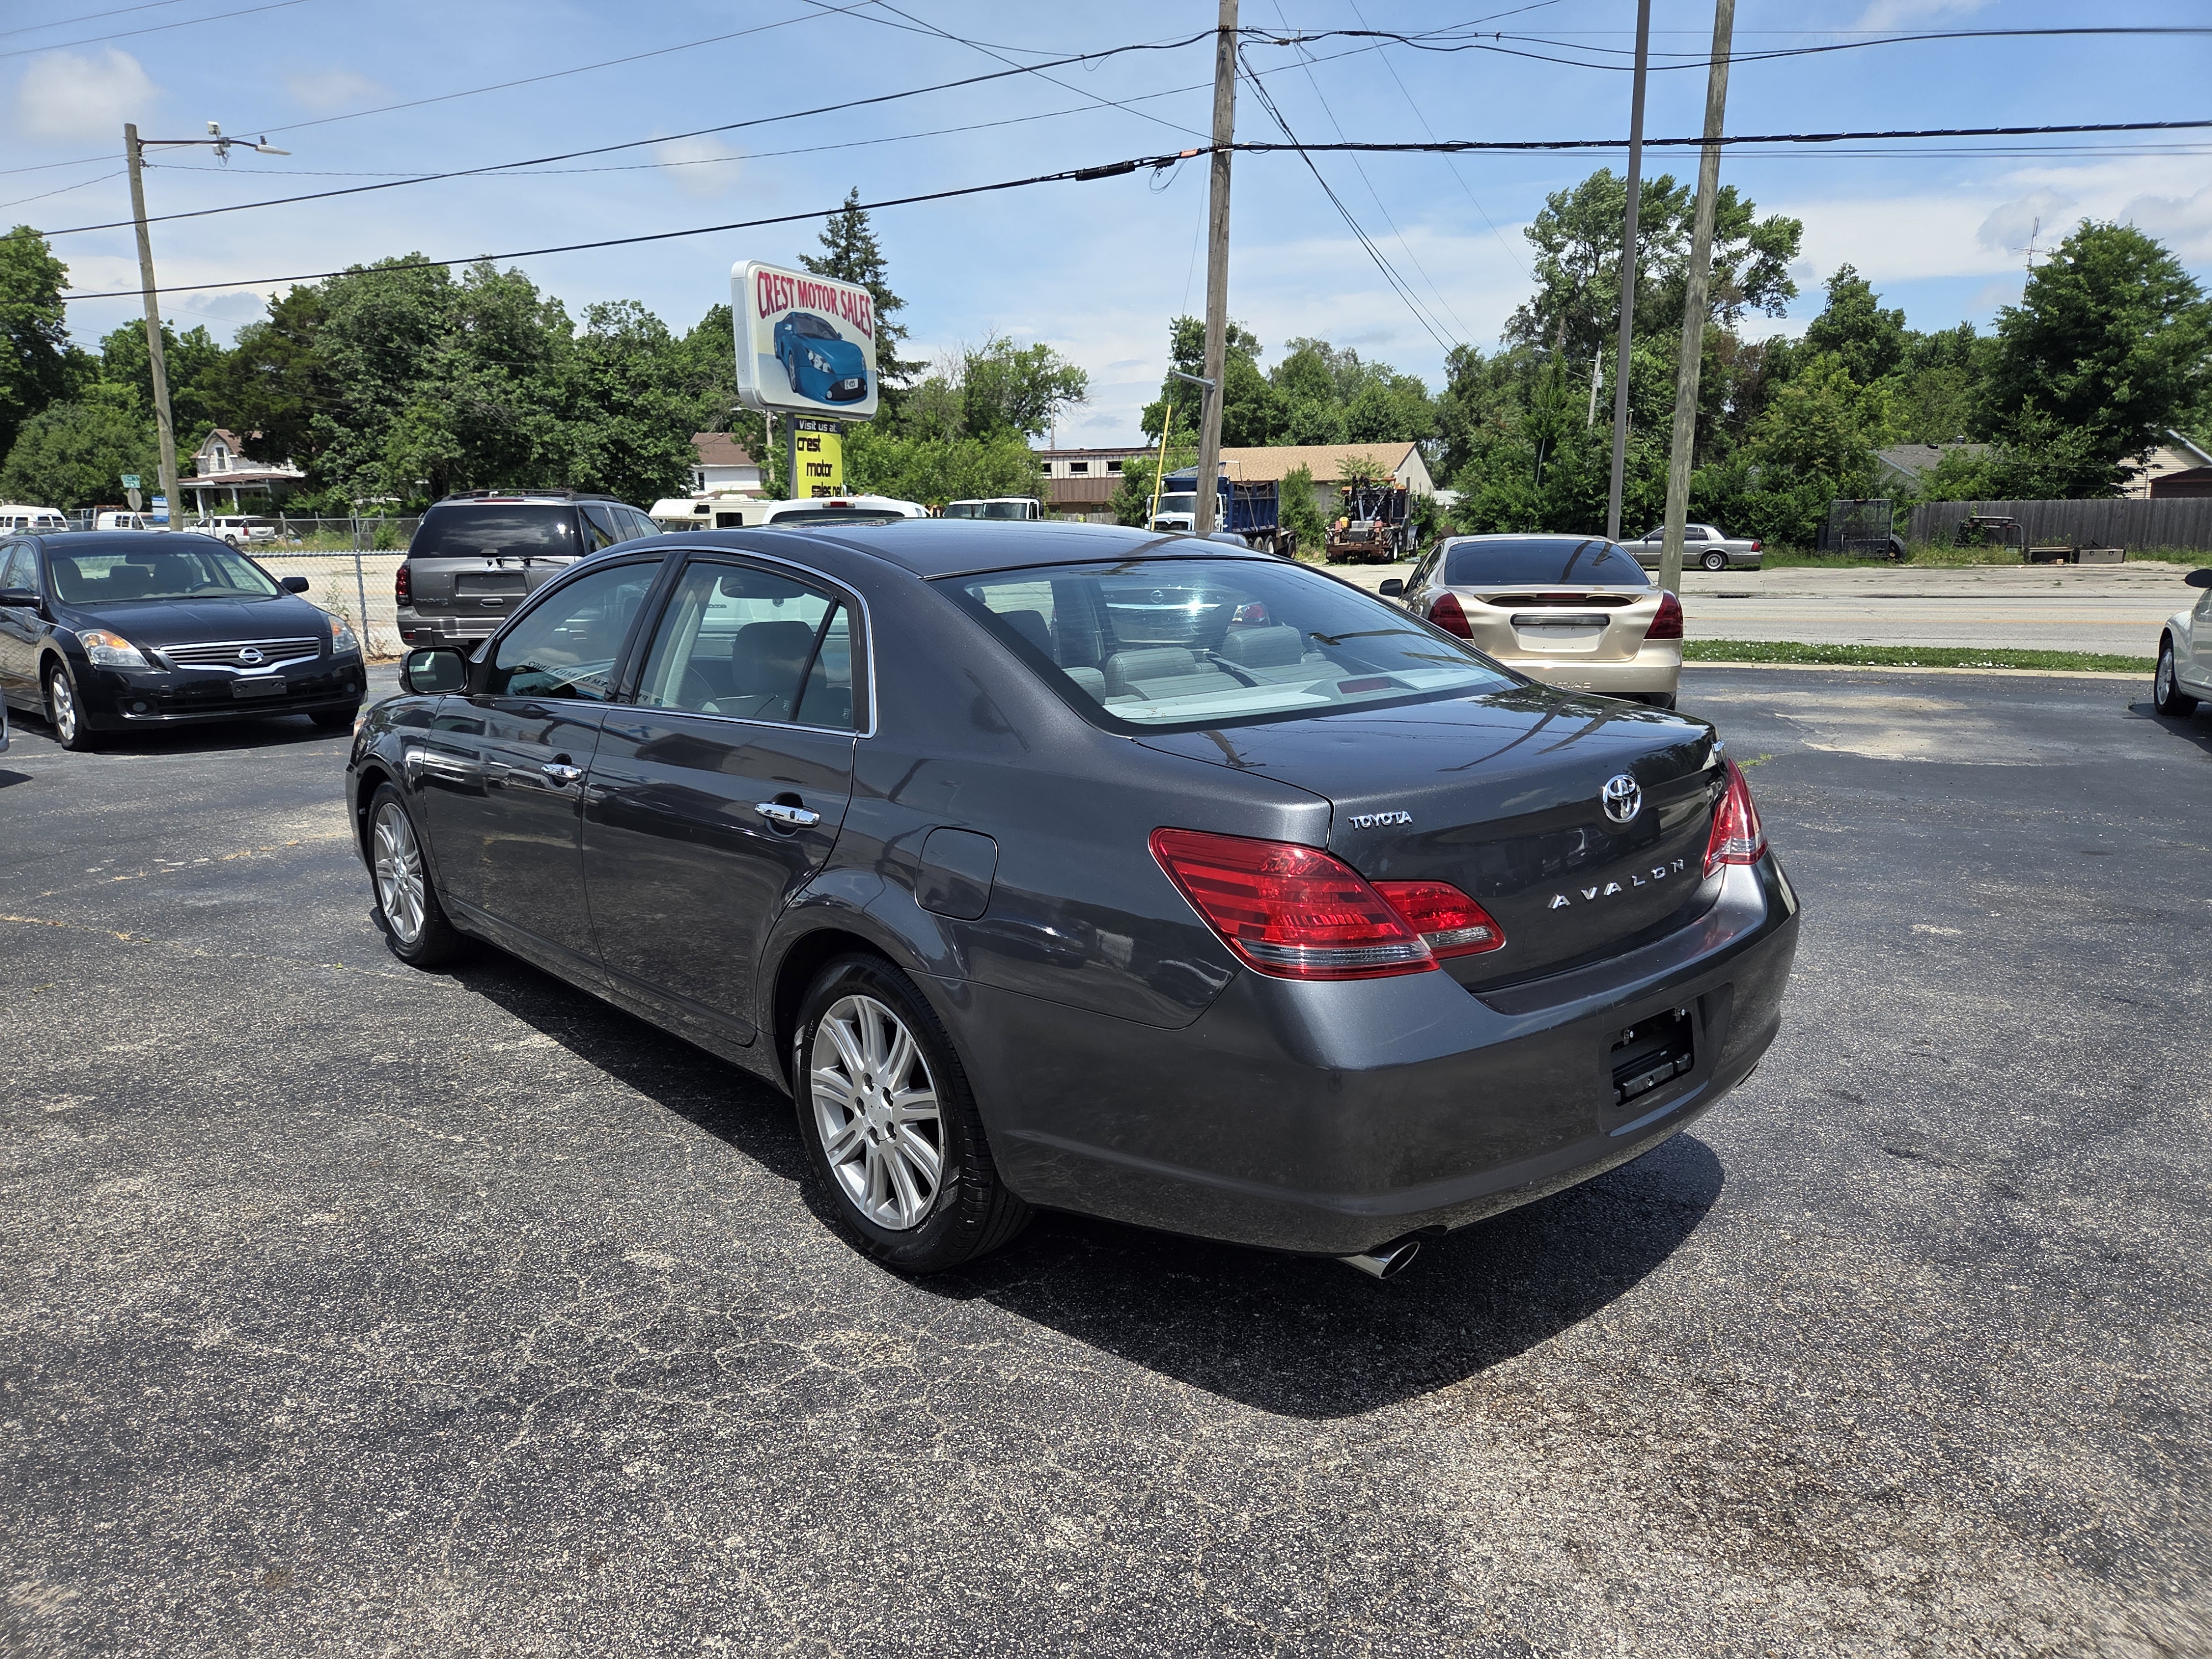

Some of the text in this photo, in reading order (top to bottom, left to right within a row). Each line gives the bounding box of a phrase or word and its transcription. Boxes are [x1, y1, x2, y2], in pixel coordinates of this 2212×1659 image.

[757, 270, 872, 341] CREST MOTOR SALES
[799, 420, 817, 430] Visit
[818, 423, 828, 431] us
[797, 434, 821, 452] crest
[806, 459, 833, 478] motor
[1348, 811, 1413, 829] TOYOTA
[1547, 859, 1684, 909] AVALON
